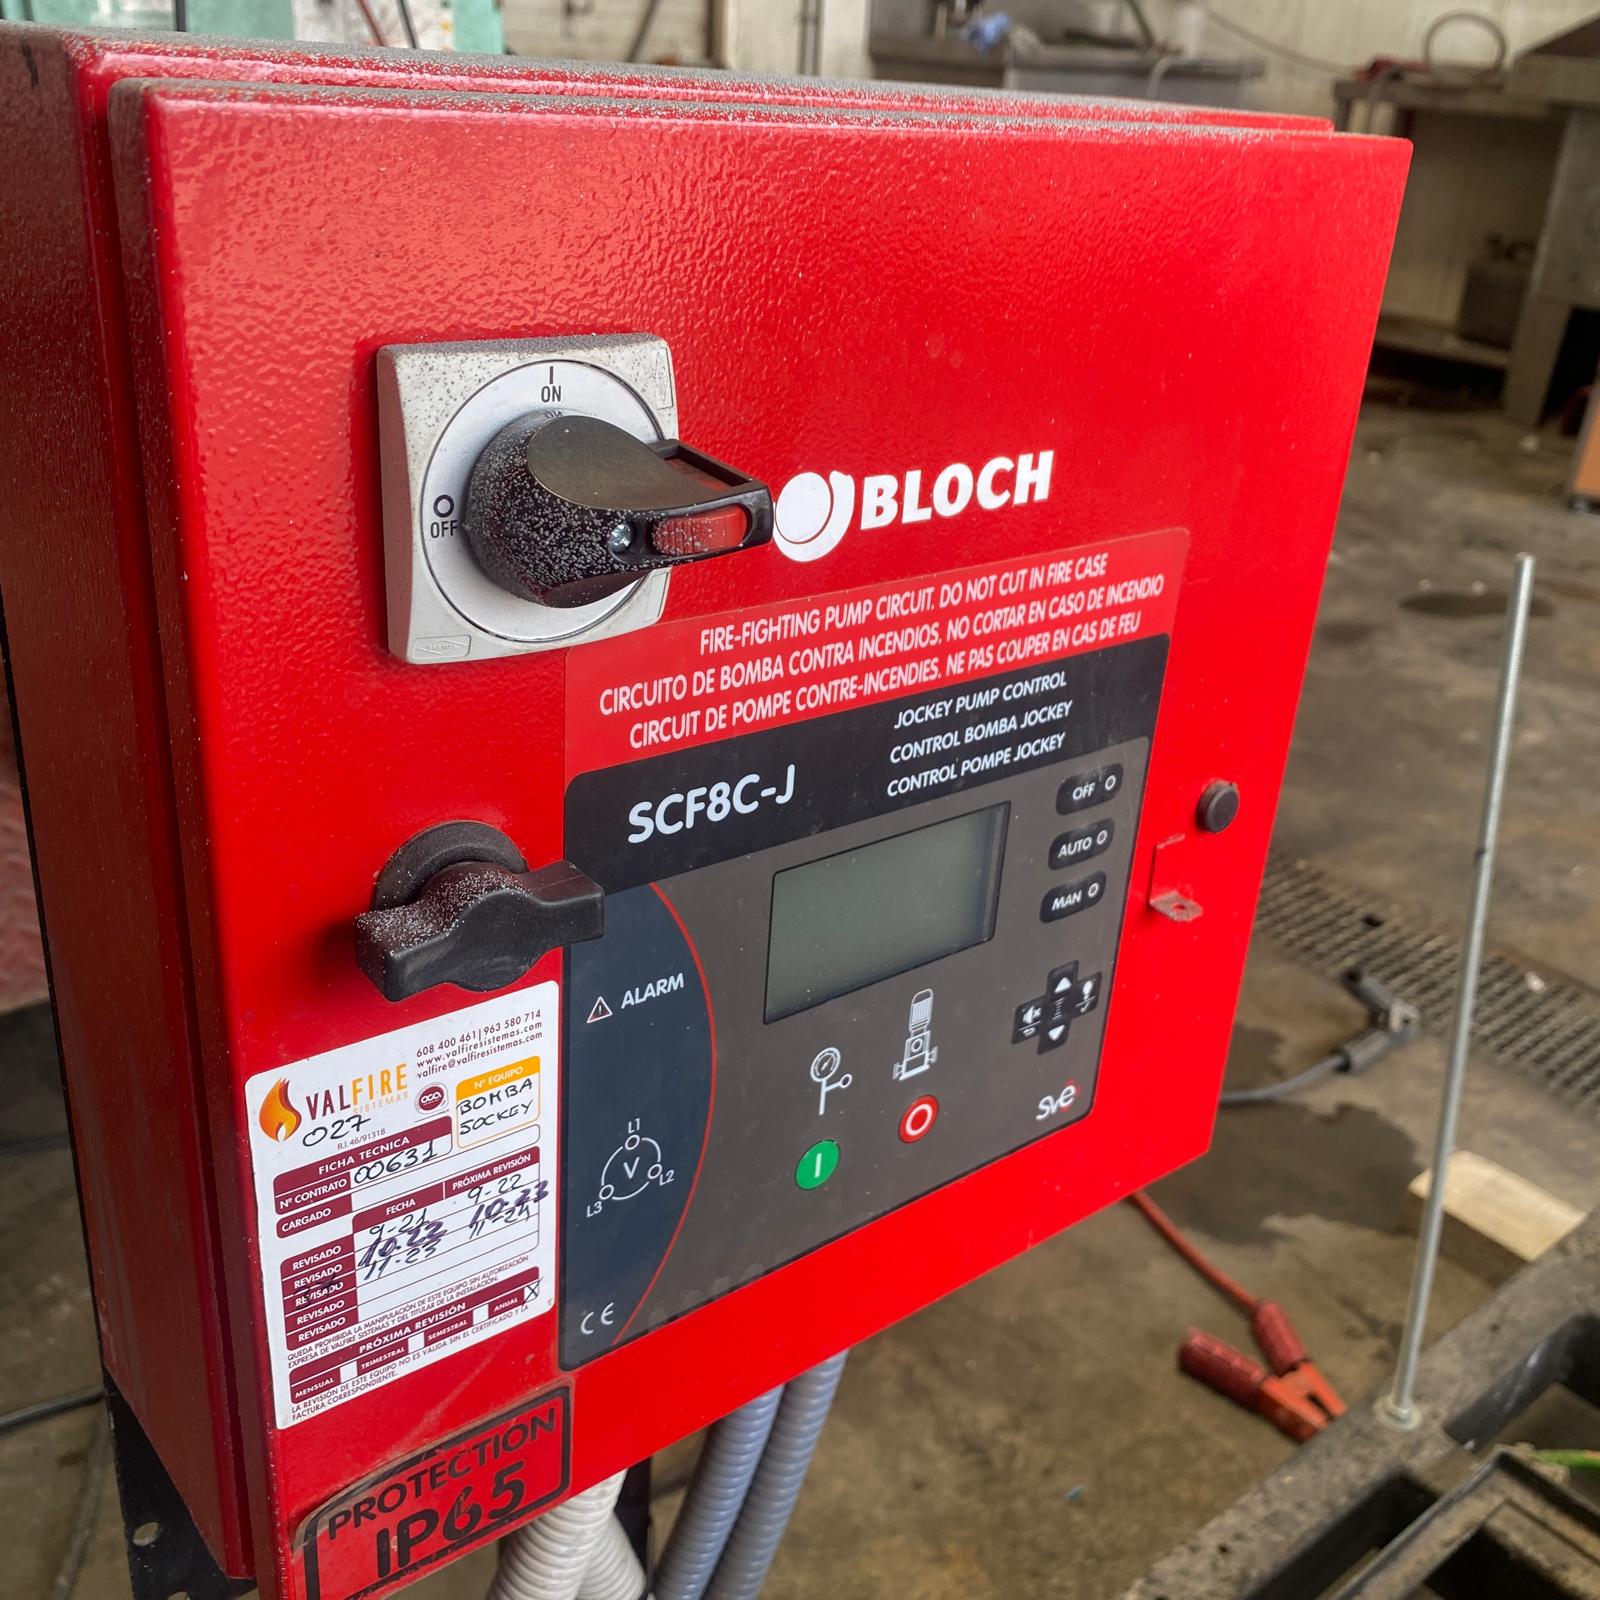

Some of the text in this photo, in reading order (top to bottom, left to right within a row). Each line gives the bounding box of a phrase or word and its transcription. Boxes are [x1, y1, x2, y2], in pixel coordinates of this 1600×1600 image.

[540, 386, 562, 403] ON
[860, 450, 1054, 530] BLOCH
[430, 521, 458, 539] OFF
[700, 553, 1108, 655] FIRE-FIGHTING PUMP CIRCUIT. DO NOT CUT IN FIRE CASE
[600, 573, 1164, 715] CIRCUITO DE BOMBA CONTRA INCENDIOS. NO CORTAR EN CASO DE INCENDIO
[629, 610, 1141, 749] CIRCUIT DE POMPE CONTRE-INCENDIES. NE PAS COUPER EN CAS DE FEU
[893, 671, 1067, 730] JOCKEY PUMP CONTROL
[889, 700, 1073, 764] CONTROL BOMBA JOCKEY
[886, 732, 1066, 797] CONTROL POMPE JOCKEY
[627, 764, 796, 844] SCF8C-J
[1072, 782, 1095, 800] OFF
[1058, 837, 1092, 858] AUTO
[1051, 890, 1082, 911] MAN
[621, 972, 684, 1009] ALARM
[416, 1044, 435, 1058] 608
[438, 1037, 456, 1050] 400
[504, 1016, 521, 1029] 580
[524, 1009, 541, 1023] 714
[416, 1021, 542, 1068] www.valfiresistemas.com
[417, 1032, 543, 1078] valfire@valfiresistemas.com
[488, 1066, 524, 1085] EQUIPO
[305, 1063, 408, 1121] VALFIRE
[353, 1091, 409, 1114] SISTEMAS
[302, 1114, 371, 1147] 027
[349, 1128, 386, 1146] 46/91318
[628, 1118, 640, 1135] L1
[318, 1136, 410, 1175] FICHA TECNICA
[354, 1139, 438, 1184] 00631
[623, 1156, 640, 1179] V
[452, 1153, 532, 1190] PRÓXIMA REVISIÓN
[659, 1169, 675, 1186] L2
[294, 1178, 347, 1205] CONTRATO
[281, 1207, 332, 1232] CARGADO
[386, 1198, 416, 1216] FECHA
[586, 1200, 602, 1218] L3
[293, 1246, 341, 1270] REVISADO
[294, 1264, 342, 1288] REVISADO
[287, 1255, 529, 1361] QUEDA PROHIBIDA LA MANIPULACIÓN DE ESTE EQUIPO SIN AUTORIZACIÓN
[296, 1281, 344, 1306] REVISADO
[494, 1297, 518, 1312] ANUAL
[297, 1300, 345, 1324] REVISADO
[288, 1353, 318, 1369] EXPRESA
[320, 1346, 329, 1355] DE
[331, 1336, 357, 1351] VALFIRE
[358, 1322, 390, 1341] SISTEMAS
[397, 1314, 409, 1323] DEL
[410, 1303, 436, 1317] TITULAR
[437, 1298, 445, 1307] DE
[298, 1316, 346, 1342] REVISADO
[359, 1302, 466, 1353] PRÓXIMA REVISIÓN
[428, 1320, 468, 1341] SEMESTRAL
[292, 1404, 301, 1413] LA
[340, 1383, 349, 1392] DE
[351, 1375, 367, 1387] ESTE
[369, 1363, 396, 1380] EQUIPO
[398, 1356, 411, 1367] NO
[412, 1352, 421, 1360] ES
[449, 1336, 461, 1345] SIN
[462, 1331, 470, 1339] EL
[471, 1312, 513, 1334] CERTIFICADO
[520, 1304, 529, 1312] LA
[361, 1347, 405, 1370] TRIMESTRAL
[291, 1370, 398, 1421] FACTURA CORRESPONDIENTE.
[295, 1377, 335, 1398] MENSUAL
[328, 1407, 556, 1541] PROTECTION
[376, 1461, 526, 1579] IP65
